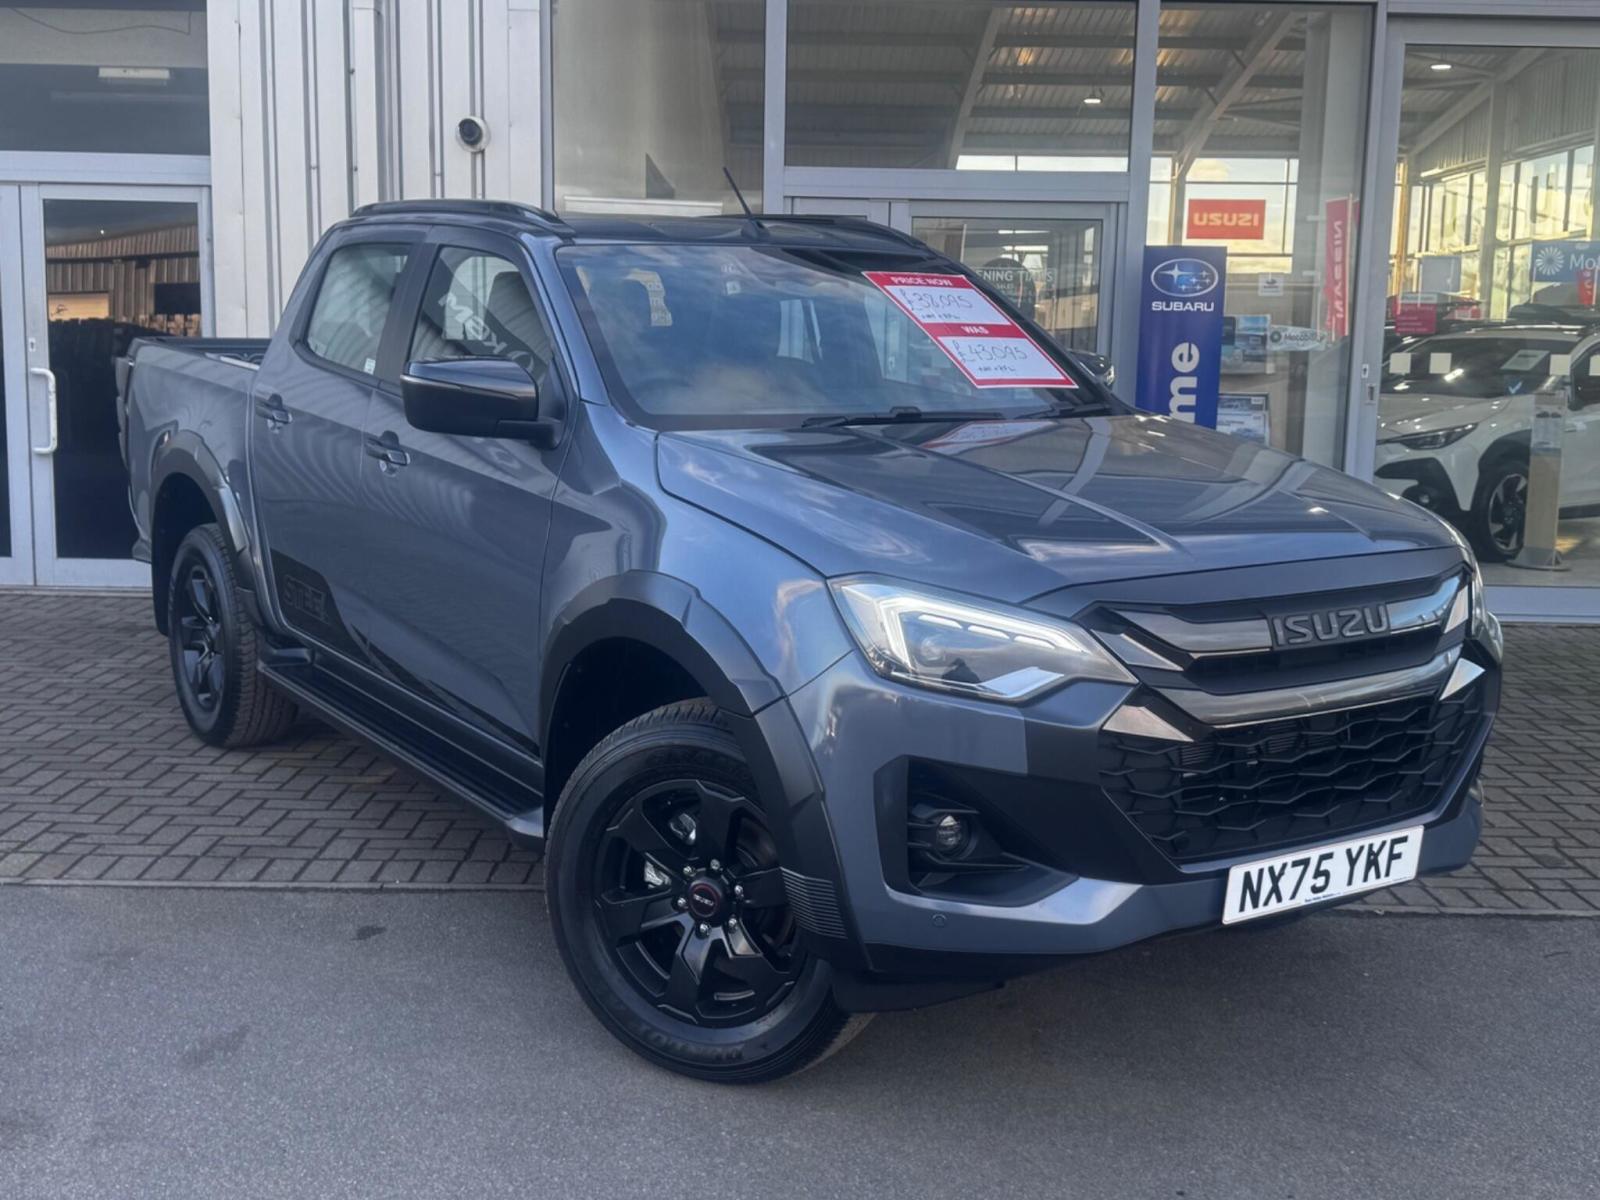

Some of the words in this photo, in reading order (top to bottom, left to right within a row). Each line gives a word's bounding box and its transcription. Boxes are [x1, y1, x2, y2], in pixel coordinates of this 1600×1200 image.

[890, 276, 926, 286] PRICE
[926, 277, 954, 287] NOW
[1151, 301, 1215, 312] SUBARU
[961, 325, 989, 334] WAS
[1272, 604, 1389, 646] ISUZU
[1239, 851, 1335, 913] NX75
[1345, 834, 1409, 887] YKF
